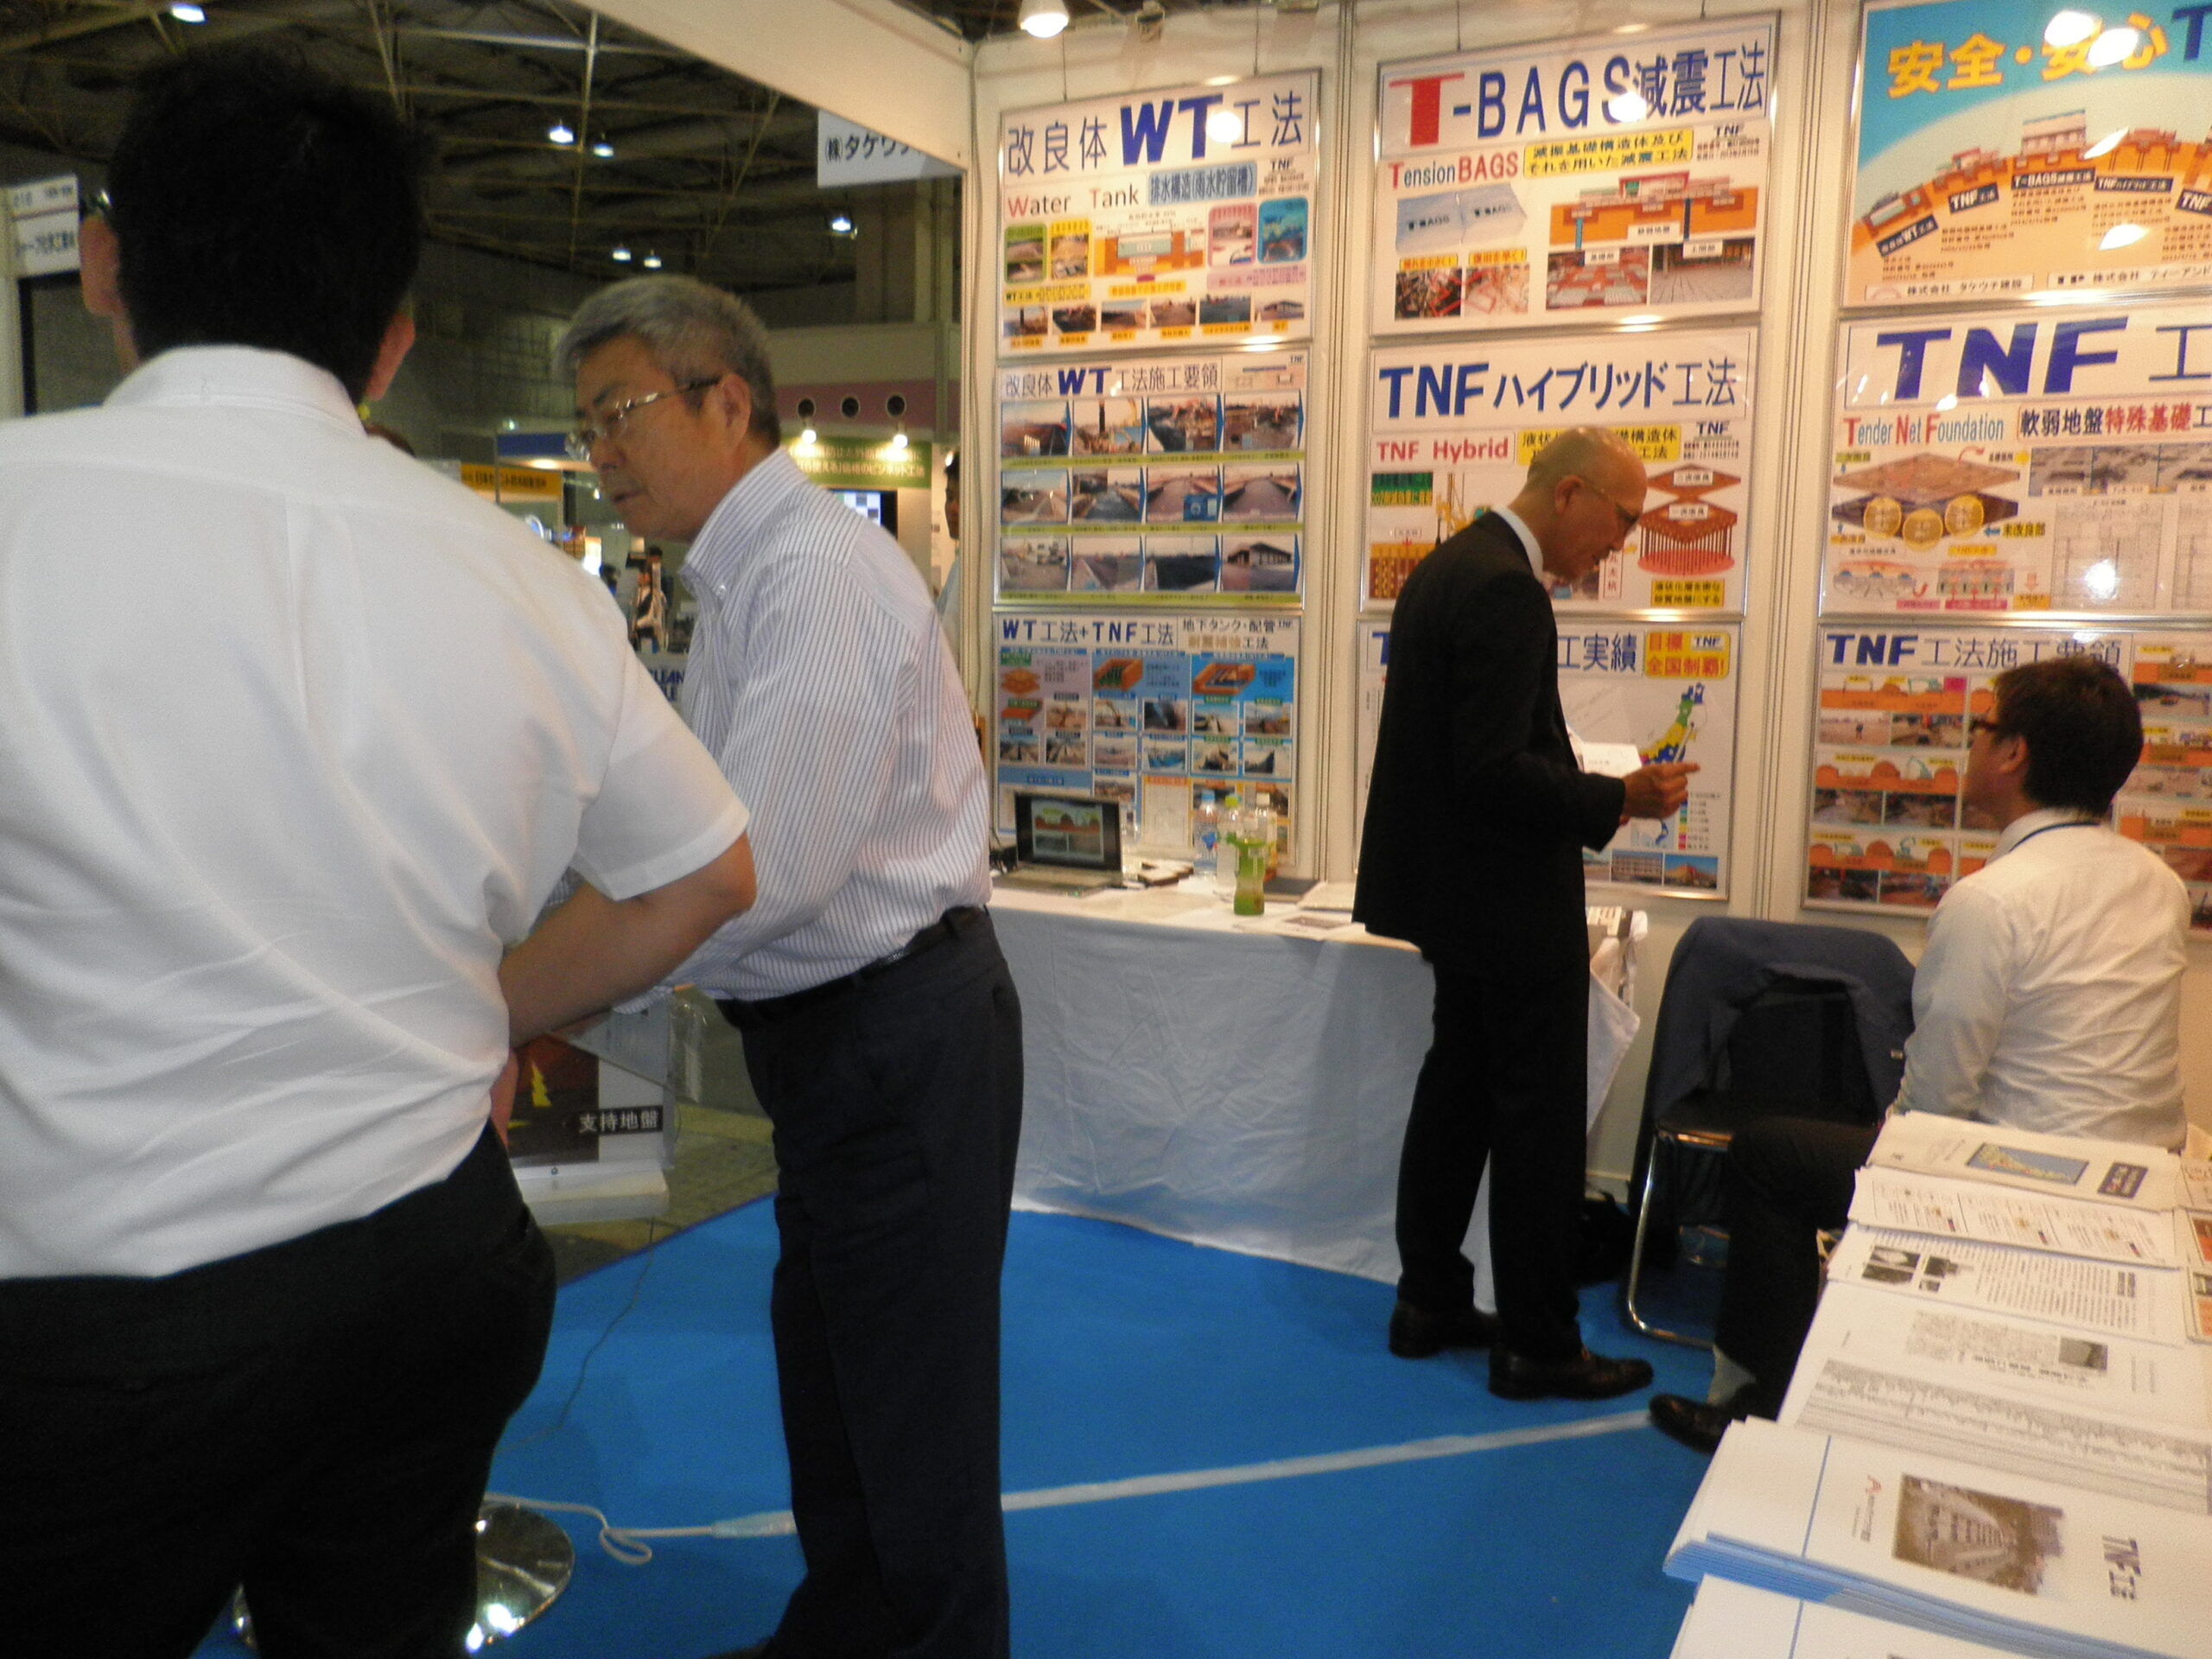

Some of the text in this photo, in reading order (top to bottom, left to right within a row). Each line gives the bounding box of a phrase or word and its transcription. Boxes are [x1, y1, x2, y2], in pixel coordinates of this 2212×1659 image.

[1008, 183, 1140, 218] Water Tank
[1696, 420, 1730, 435] TNF
[1843, 413, 2004, 446] Tender Net Foundation
[1376, 436, 1509, 464] TNF Hybrid
[1694, 635, 1721, 646] TNF
[578, 1109, 660, 1135] 支持地盤
